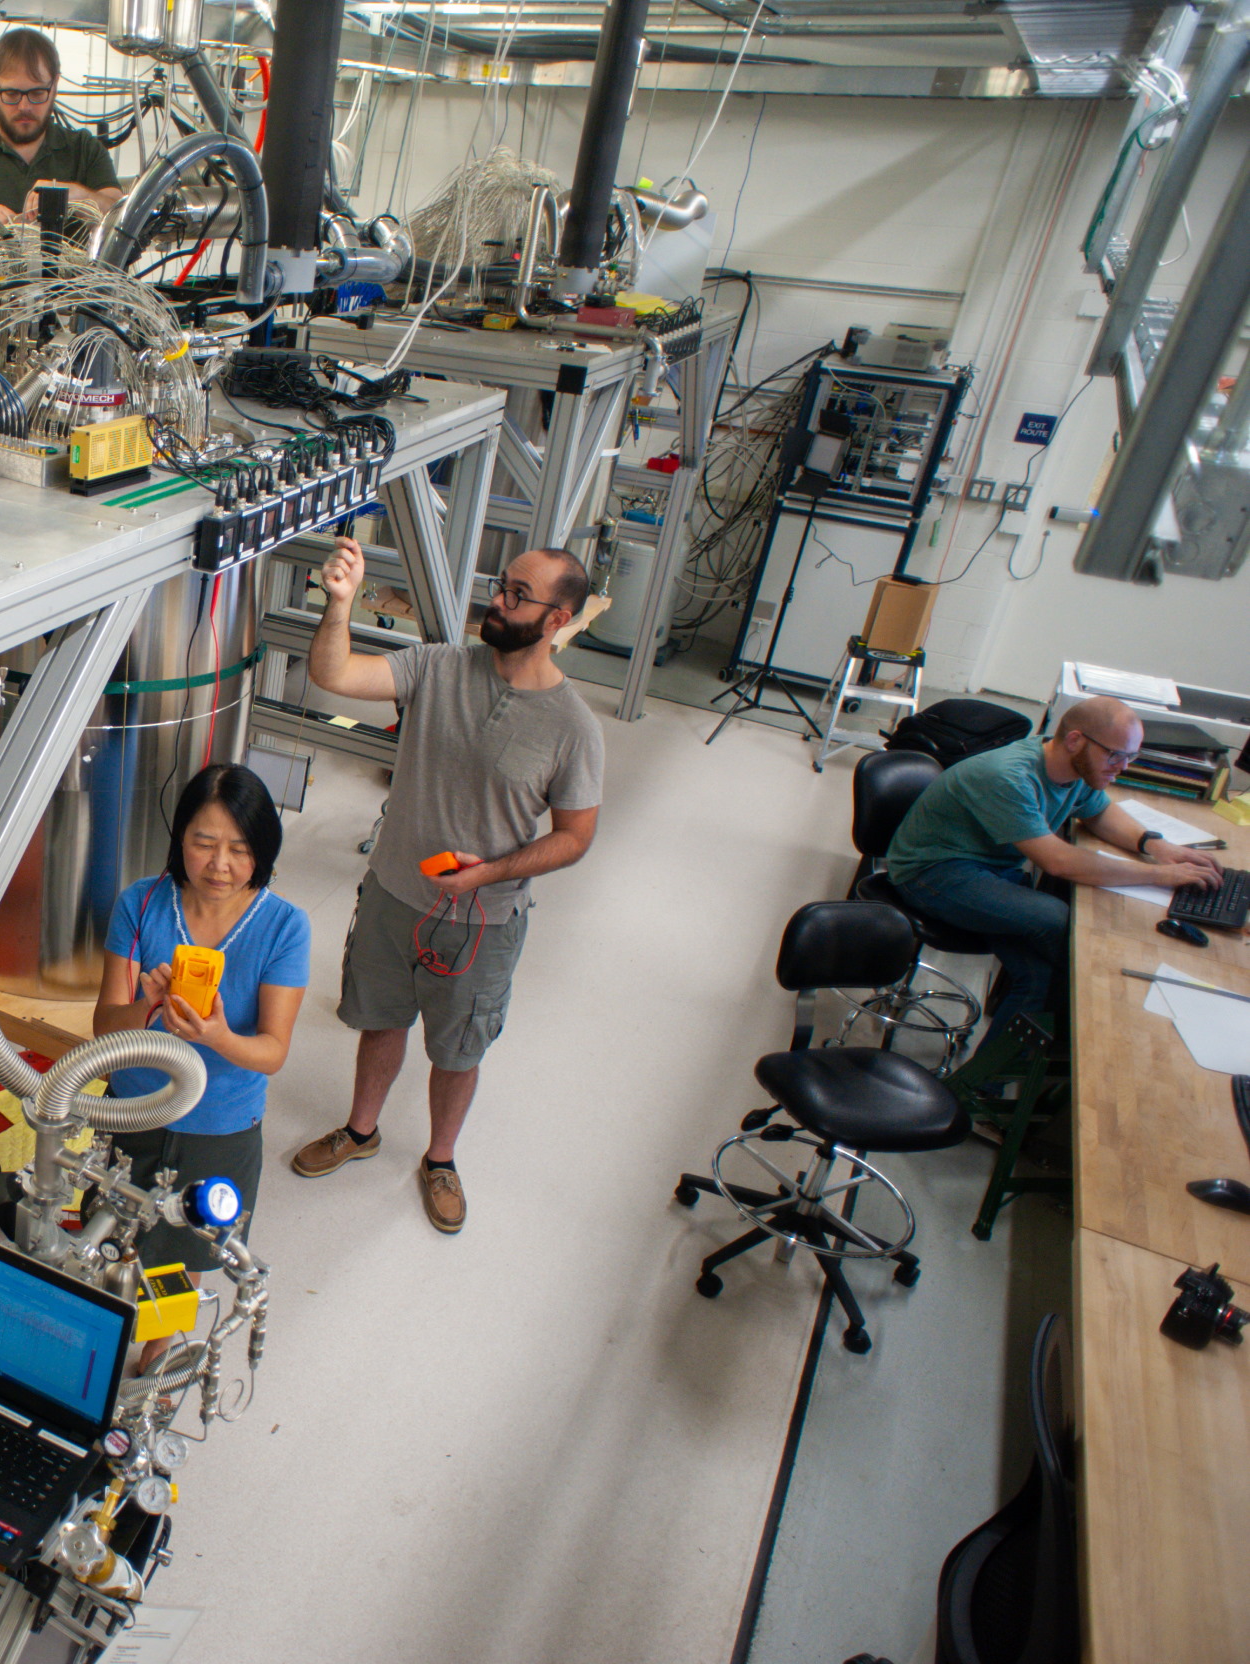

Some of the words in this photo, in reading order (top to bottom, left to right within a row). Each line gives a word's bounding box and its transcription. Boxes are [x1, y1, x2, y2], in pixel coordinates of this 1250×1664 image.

[58, 390, 115, 403] RYOMECH
[1027, 421, 1047, 429] EXIT
[1020, 428, 1049, 438] ROUTE
